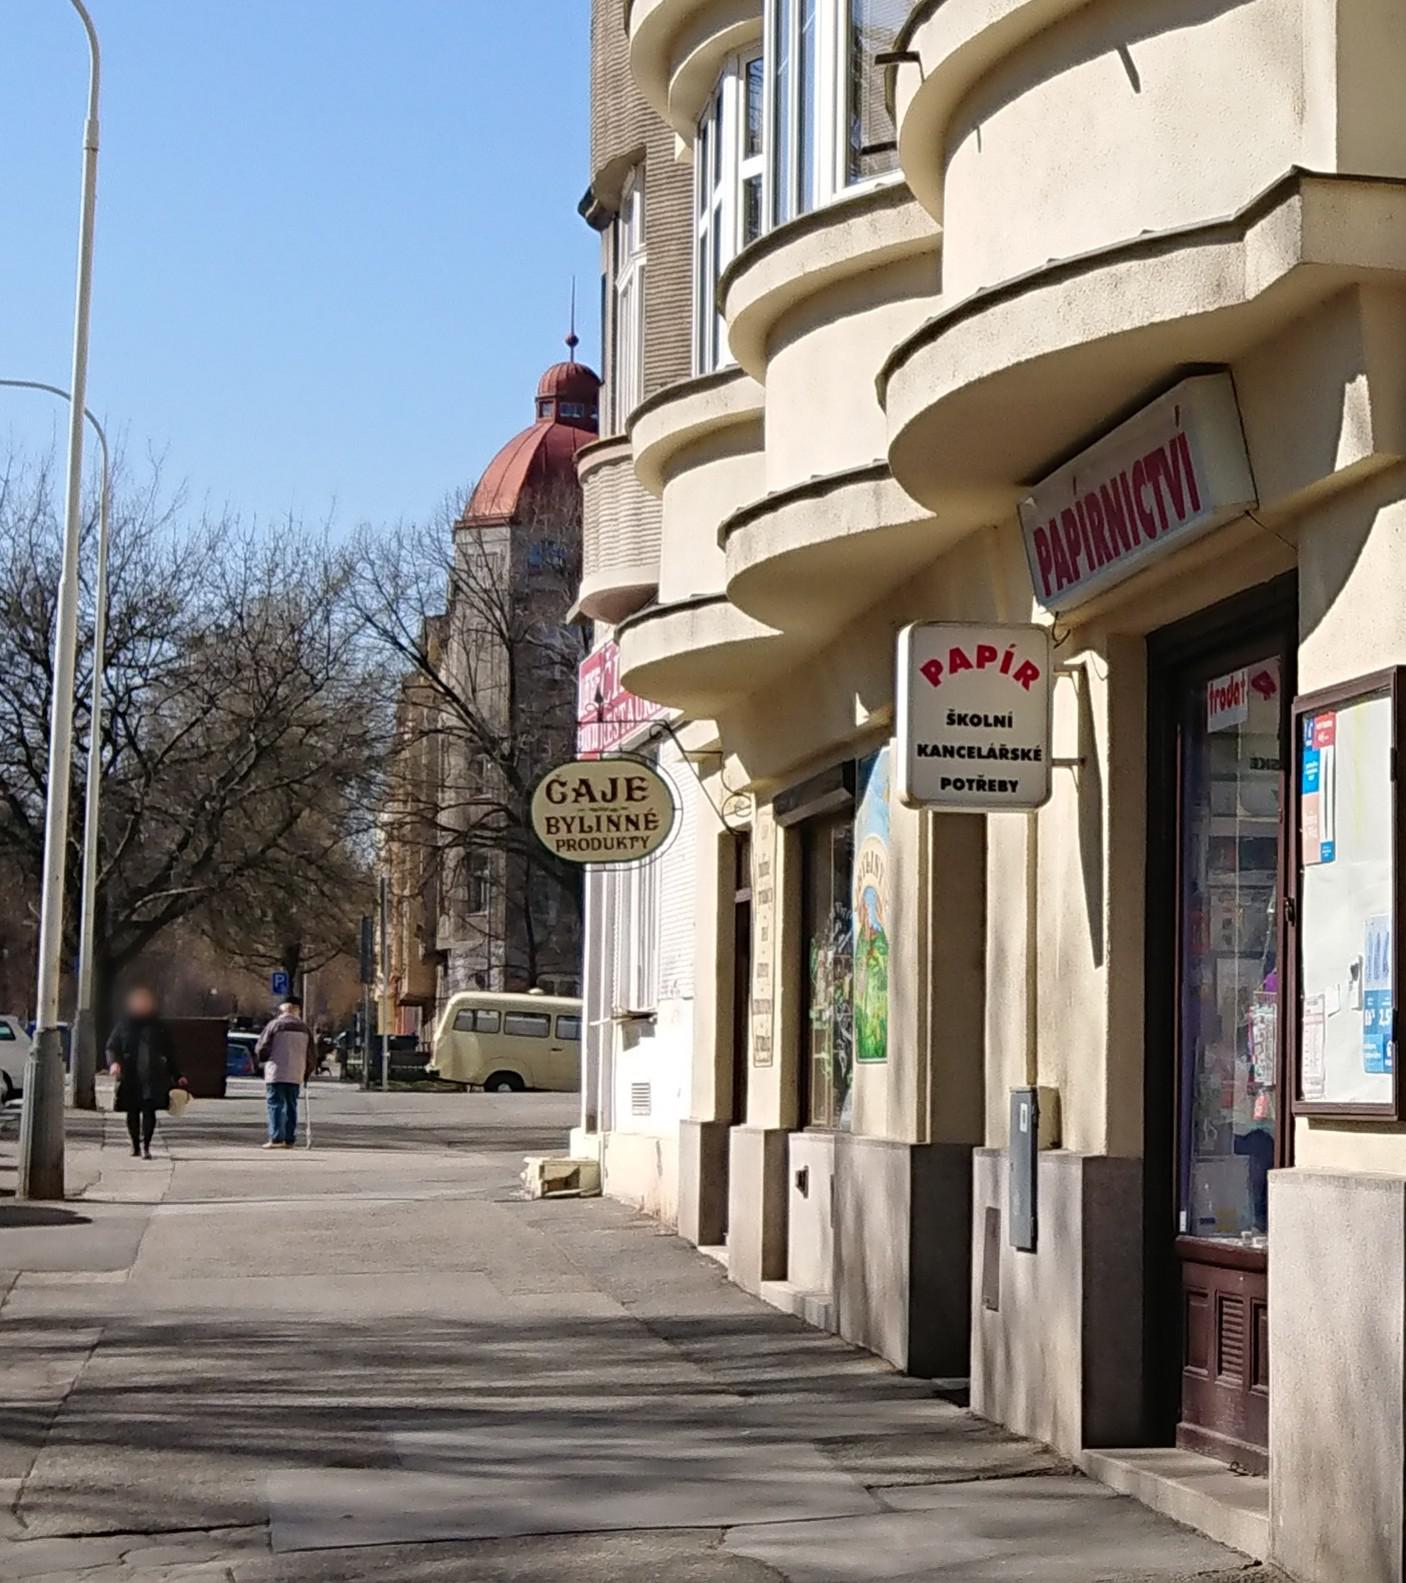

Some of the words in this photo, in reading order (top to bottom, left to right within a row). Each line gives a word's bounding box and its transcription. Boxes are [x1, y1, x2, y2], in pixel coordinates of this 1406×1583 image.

[1032, 404, 1201, 598] PAPÍRNICTVÍ
[919, 643, 1041, 692] PAPÍR
[1208, 670, 1246, 716] trodat
[946, 709, 1013, 729] ŠKOLNÍ
[916, 742, 1042, 762] KANCELÁŘSKÉ
[545, 773, 649, 805] ČAJE
[940, 774, 1019, 793] POTŘEBY
[544, 807, 660, 835] BYLINNÉ
[555, 836, 650, 852] PRODUKTY
[274, 973, 286, 989] P
